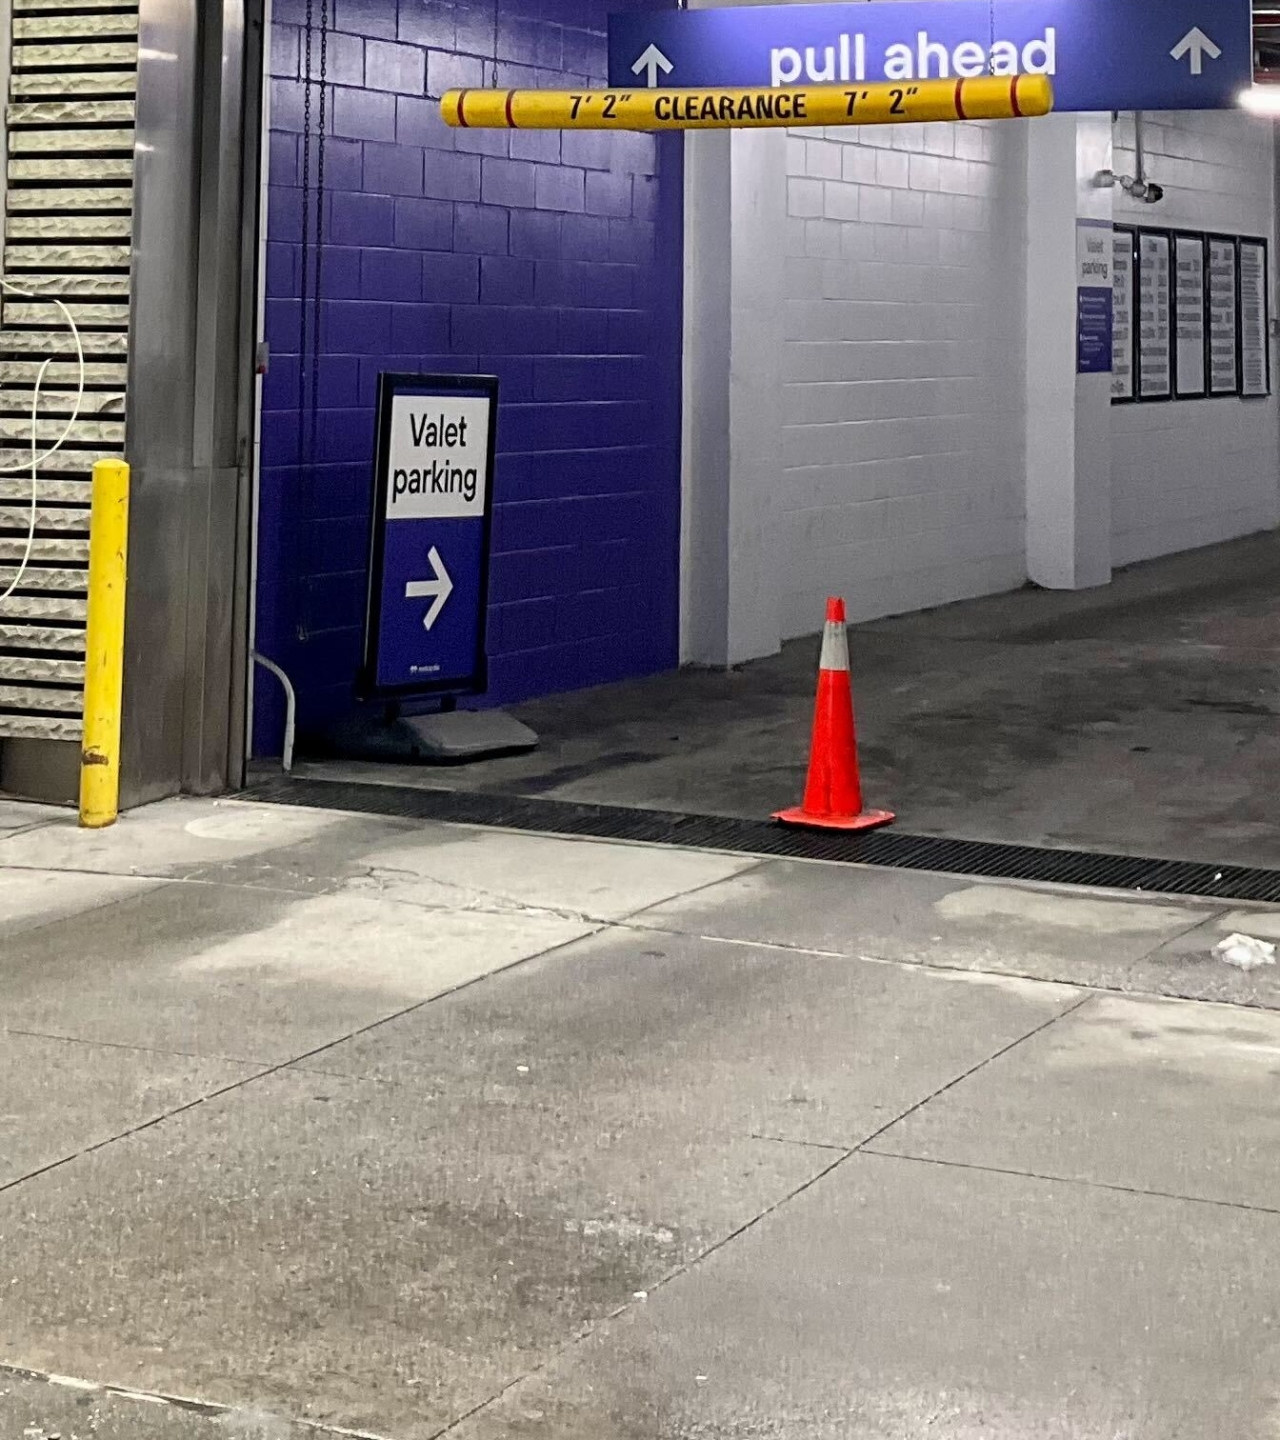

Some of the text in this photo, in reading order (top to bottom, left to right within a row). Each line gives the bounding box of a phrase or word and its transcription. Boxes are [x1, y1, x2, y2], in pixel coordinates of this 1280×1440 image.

[770, 27, 1057, 87] pull ahead
[570, 86, 919, 121] 7' 2" CLEARANCE 7' 2"
[409, 413, 467, 448] Valet
[392, 459, 477, 503] parking
